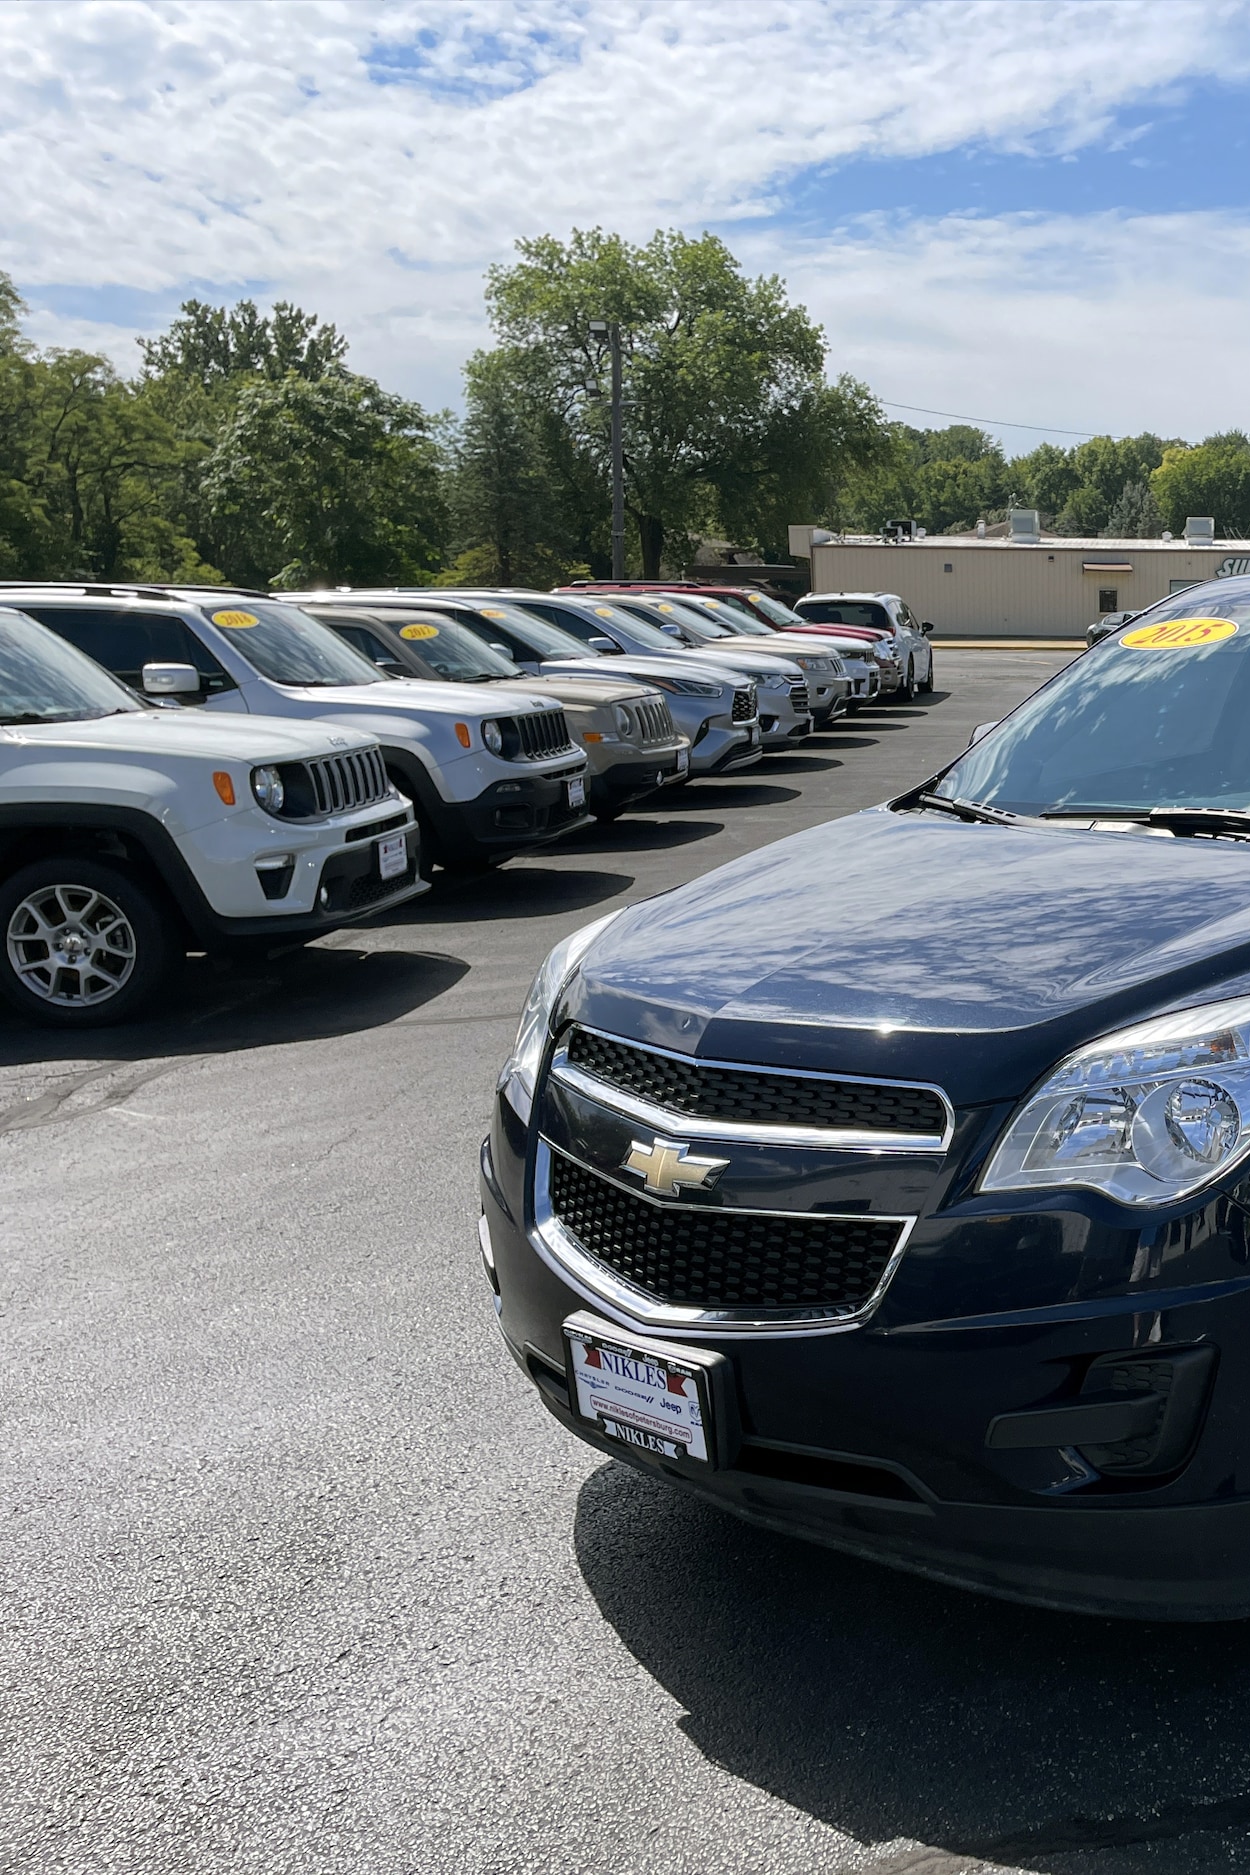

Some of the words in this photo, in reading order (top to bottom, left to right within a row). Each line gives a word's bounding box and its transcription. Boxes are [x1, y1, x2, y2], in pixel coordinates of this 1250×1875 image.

[1130, 622, 1225, 645] 2015
[600, 1351, 667, 1390] NIKLES
[574, 1369, 610, 1386] CHRYSLER
[660, 1397, 682, 1415] Jeep
[592, 1398, 691, 1440] www.niklesofpetersburg.com
[615, 1424, 666, 1454] NIKLES
